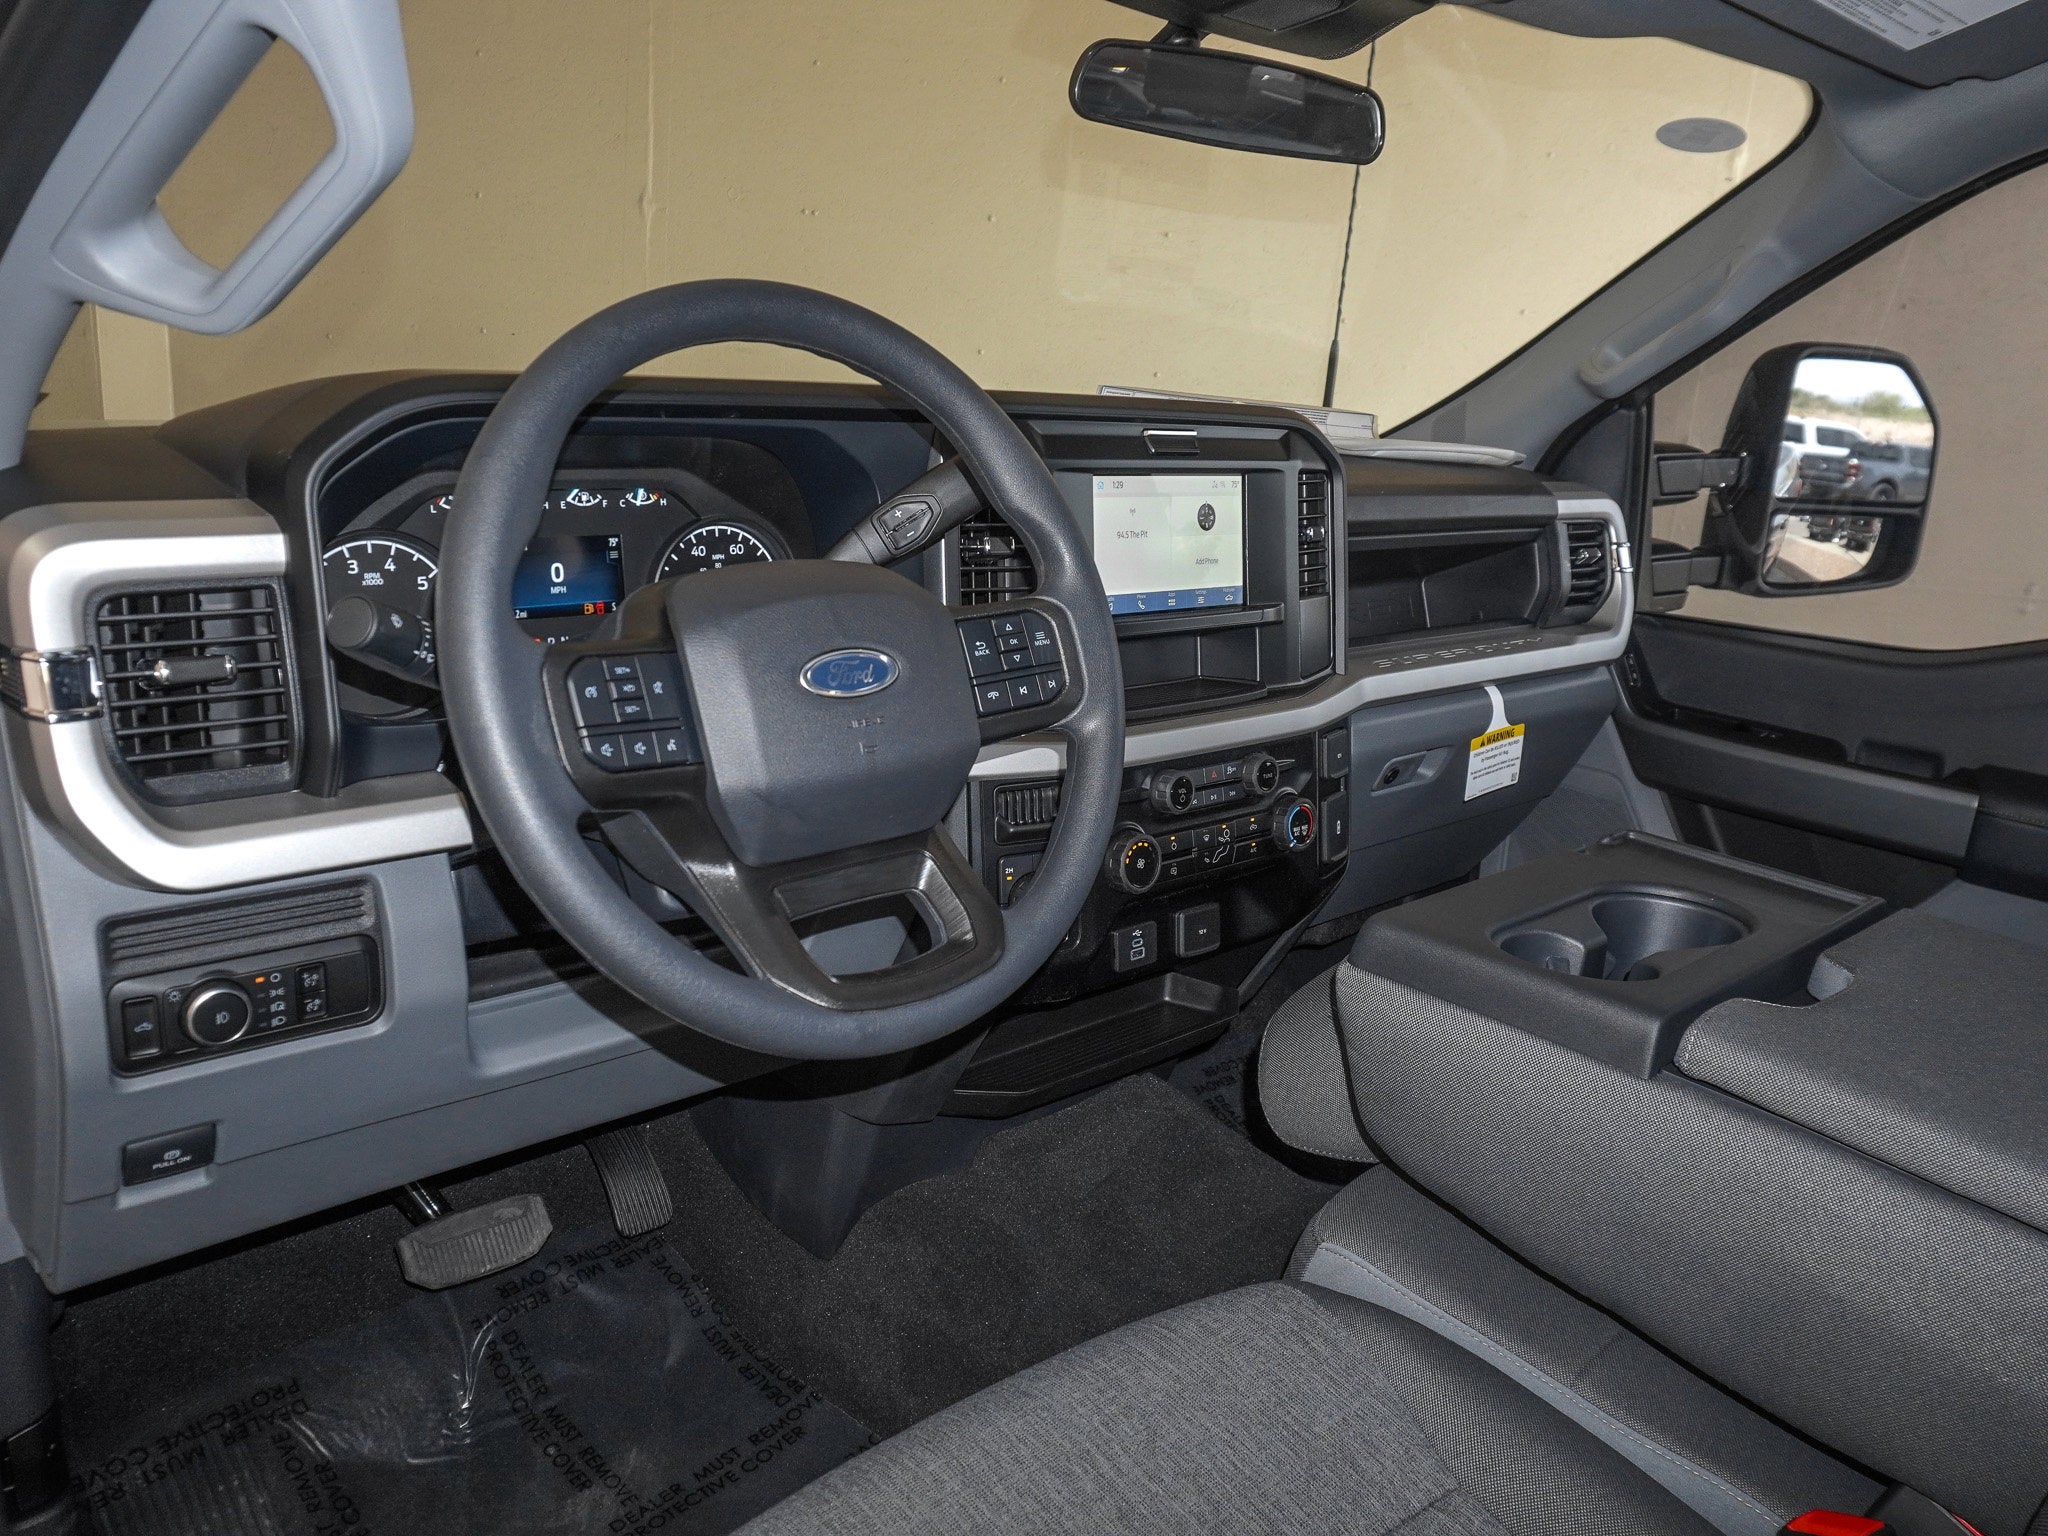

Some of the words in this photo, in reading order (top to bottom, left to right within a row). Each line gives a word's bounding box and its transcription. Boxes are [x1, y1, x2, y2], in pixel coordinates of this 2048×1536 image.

[1130, 530, 1140, 538] The
[691, 545, 706, 556] 40
[729, 543, 744, 555] 60
[347, 559, 359, 574] 3
[384, 558, 396, 572] 4
[363, 572, 381, 580] RPM
[550, 562, 565, 583] 0
[417, 576, 429, 590] 5
[974, 649, 991, 657] BACK
[827, 659, 876, 687] Ford
[1486, 728, 1515, 746] WARNING
[177, 1155, 193, 1164] ON
[487, 1339, 550, 1444] PROTECTIVE
[543, 1442, 594, 1493] COVER
[502, 1329, 548, 1400] DEALER
[543, 1404, 584, 1443] MUST
[577, 1445, 640, 1508] REMOVE
[741, 1425, 807, 1475] COVER
[608, 1482, 686, 1533] DEALER
[693, 1447, 742, 1483] MUST
[748, 1390, 824, 1446] REMOVE
